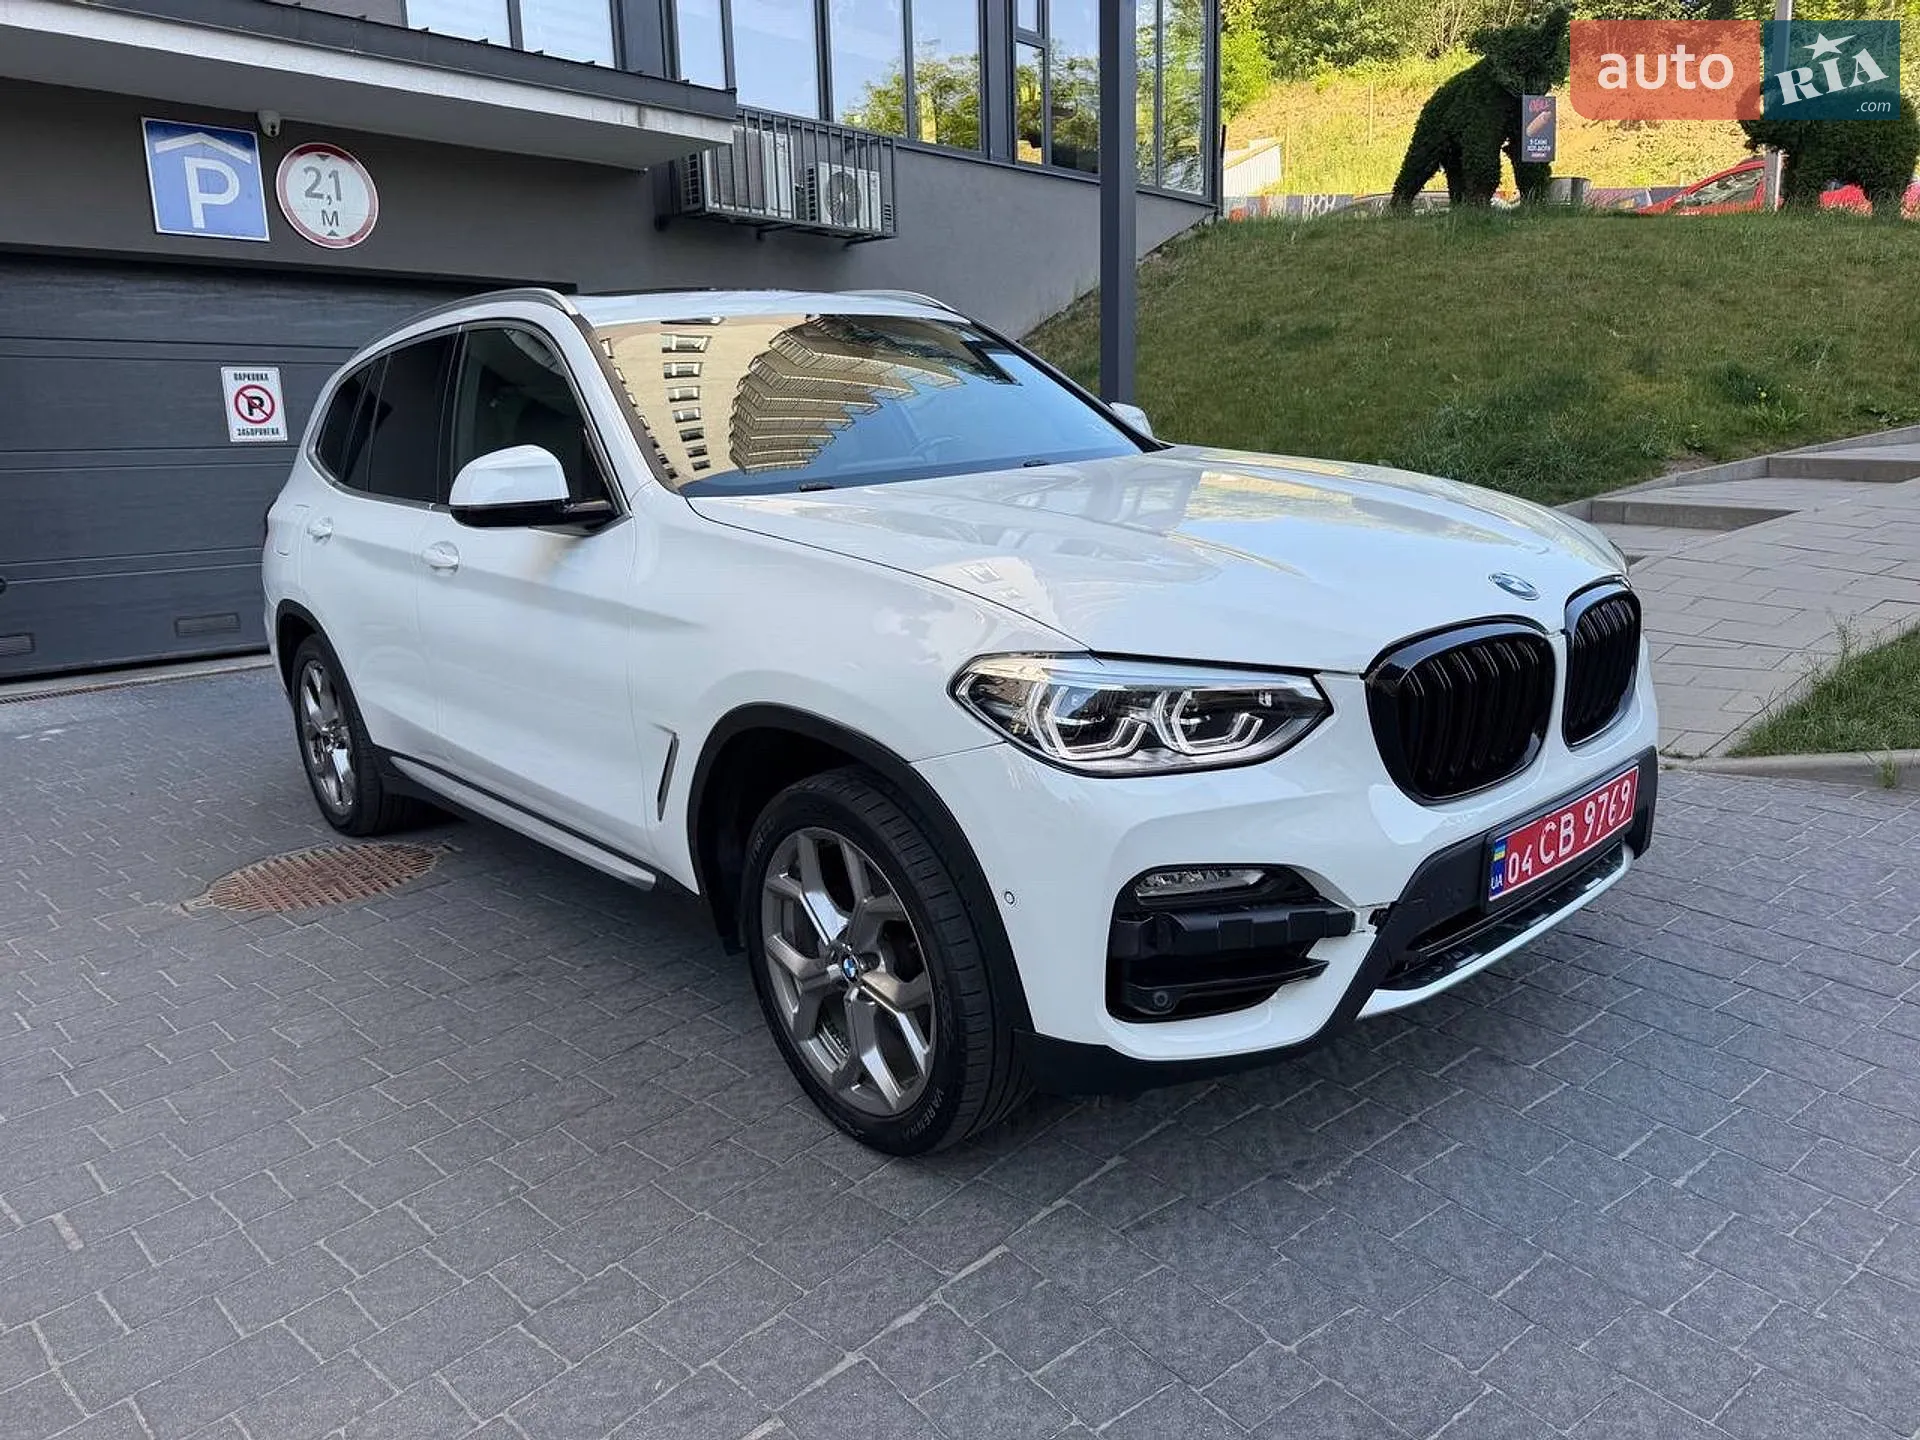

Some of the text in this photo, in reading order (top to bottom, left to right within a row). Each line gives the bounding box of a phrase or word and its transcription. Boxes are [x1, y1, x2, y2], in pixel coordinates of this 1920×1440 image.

[184, 156, 240, 229] P
[303, 166, 342, 206] 2,1
[1508, 844, 1532, 884] 04
[1583, 779, 1631, 843] 9769
[1491, 874, 1503, 890] UA
